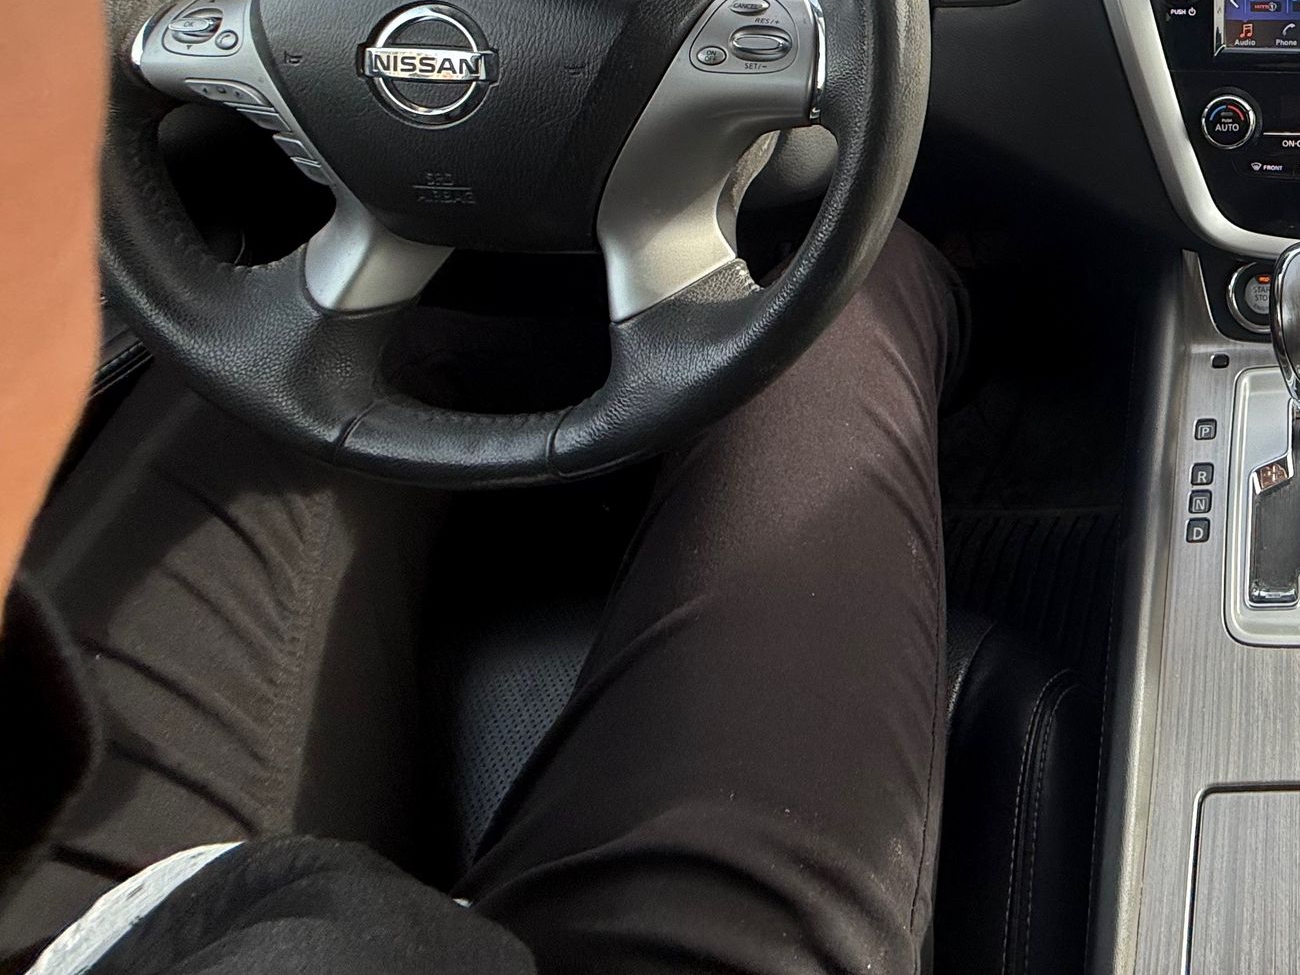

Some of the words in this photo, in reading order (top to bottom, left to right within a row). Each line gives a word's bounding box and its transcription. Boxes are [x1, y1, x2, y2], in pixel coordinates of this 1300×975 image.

[373, 54, 480, 74] NISSAN
[1215, 124, 1240, 132] AUTO
[1202, 427, 1210, 436] P
[1198, 471, 1207, 483] R
[1196, 499, 1205, 510] N
[1193, 527, 1203, 540] D
